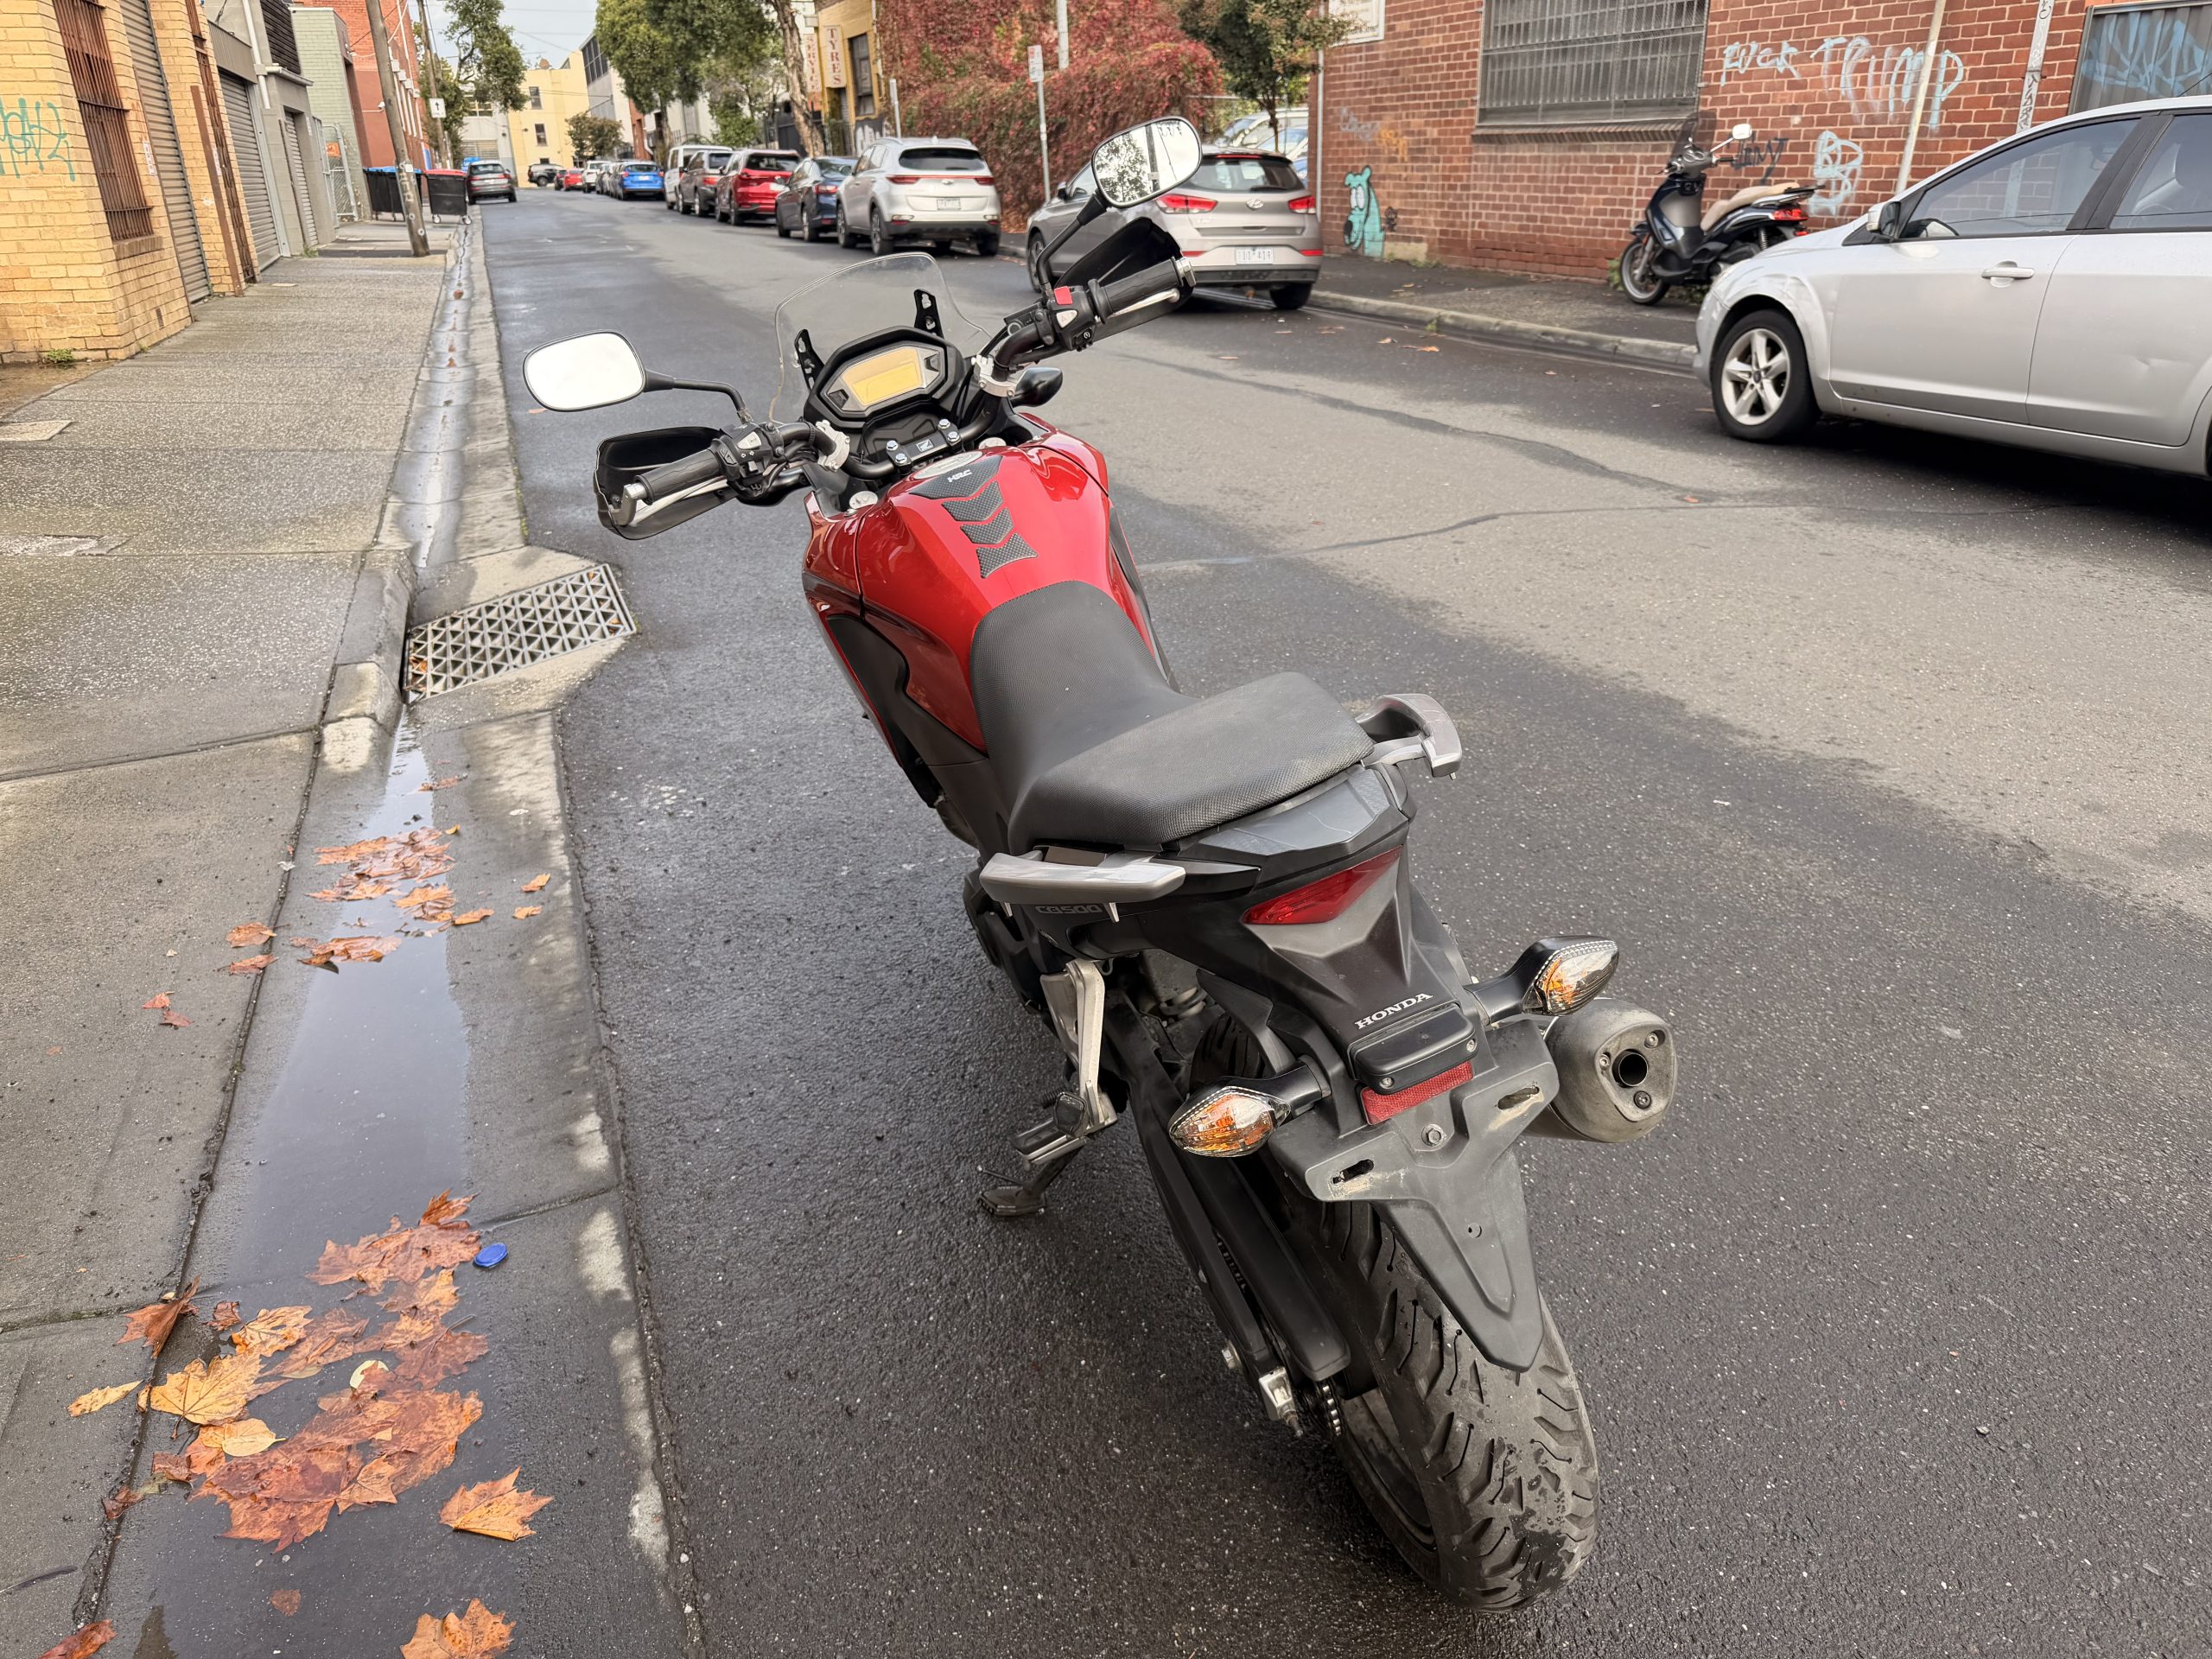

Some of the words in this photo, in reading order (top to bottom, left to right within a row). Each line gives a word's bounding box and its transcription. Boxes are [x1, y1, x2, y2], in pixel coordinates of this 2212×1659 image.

[827, 28, 842, 85] TYRES
[1810, 35, 1963, 130] TRUMP
[947, 469, 972, 483] HRC
[1354, 993, 1433, 1030] HONDA
